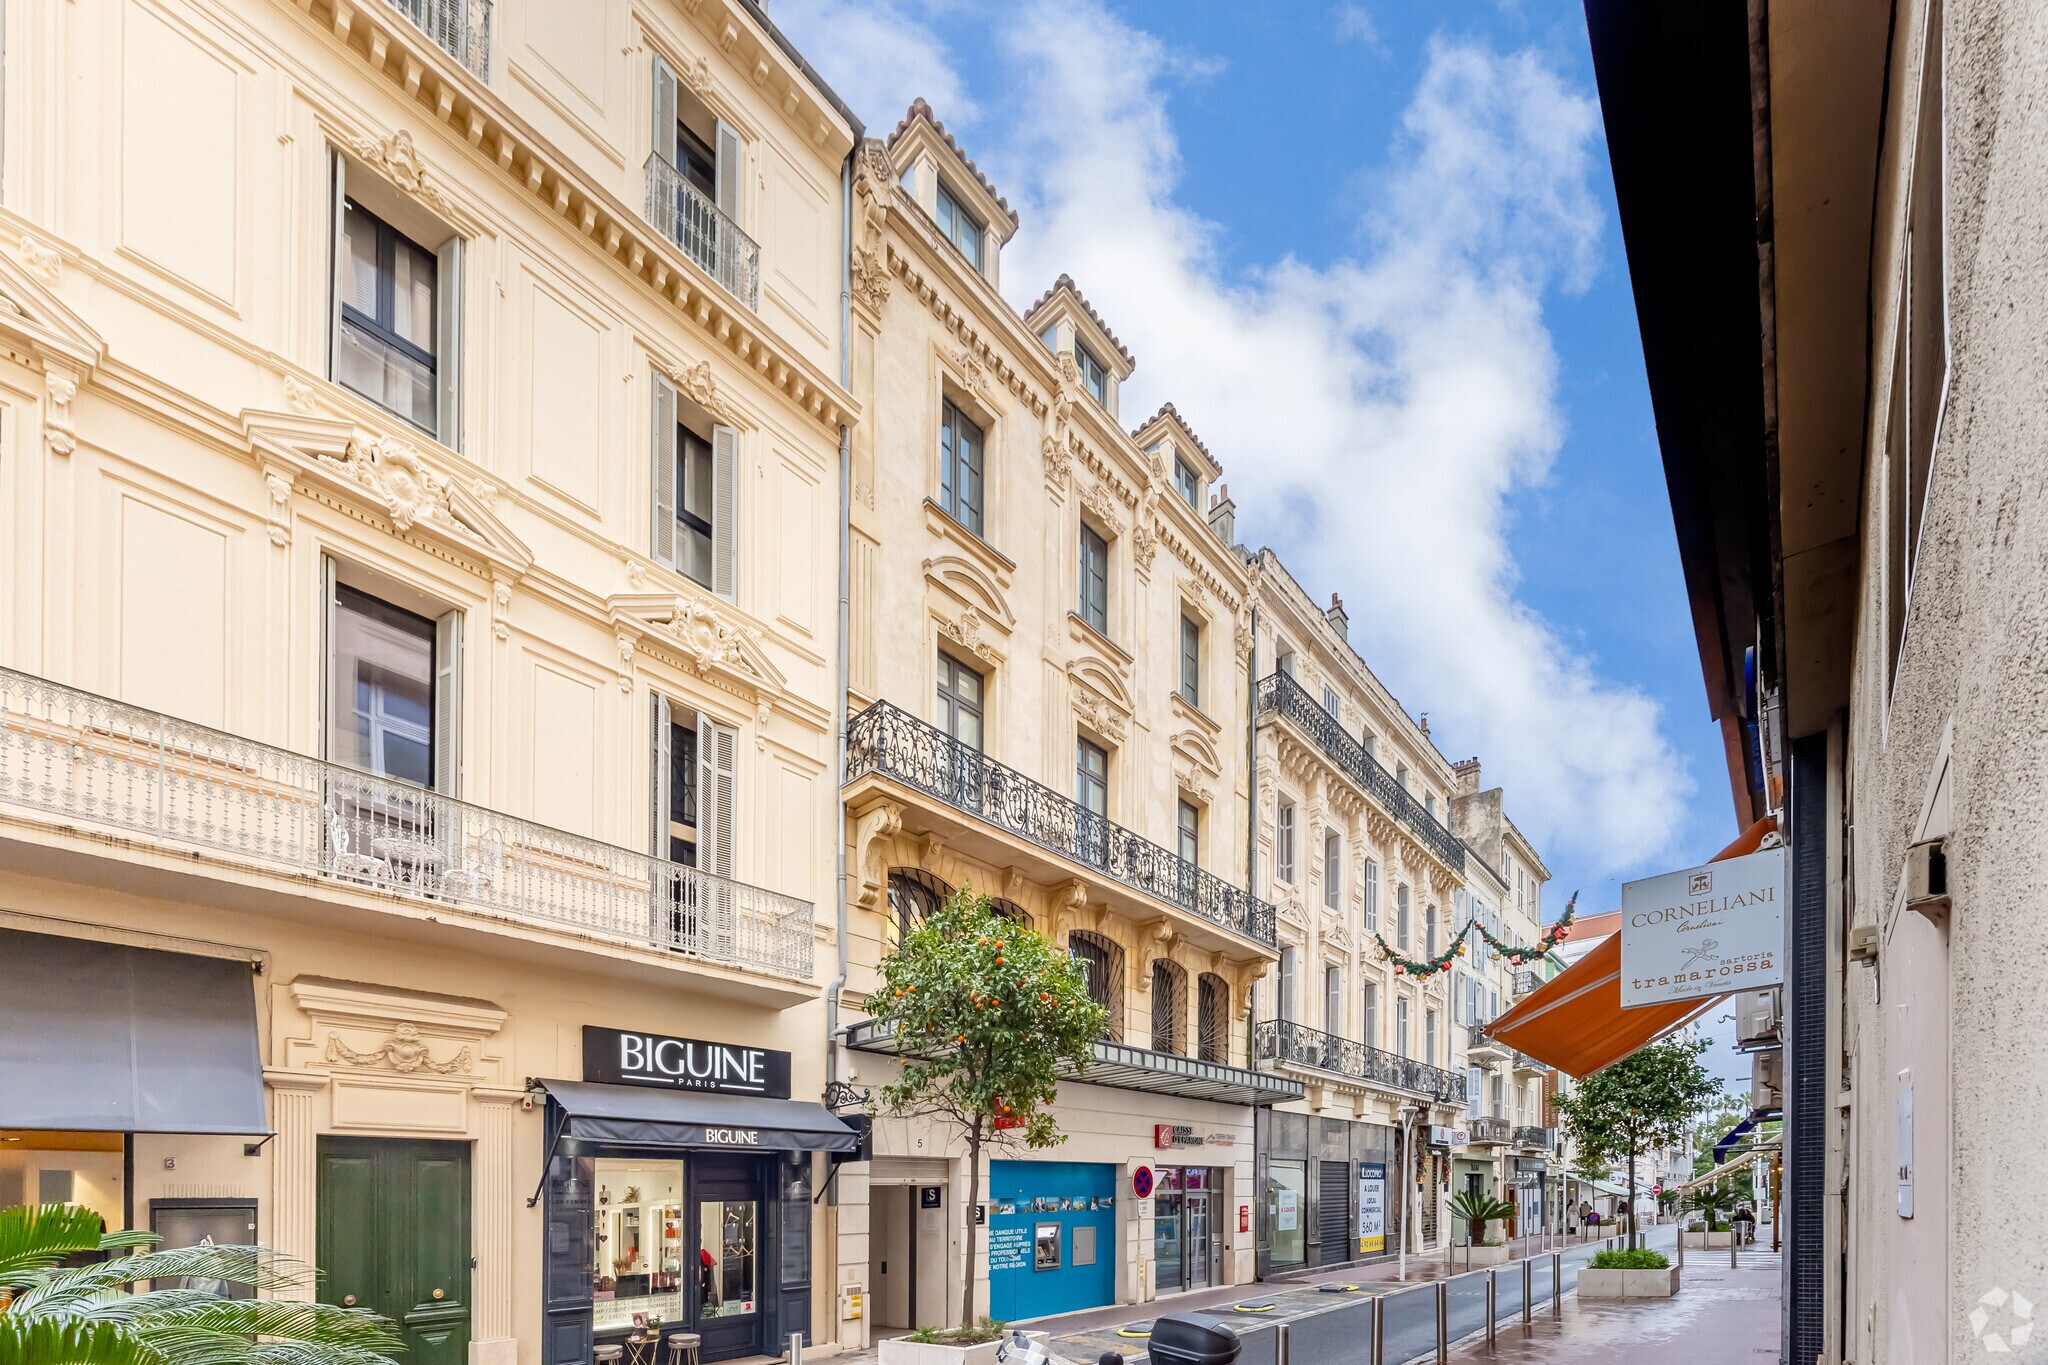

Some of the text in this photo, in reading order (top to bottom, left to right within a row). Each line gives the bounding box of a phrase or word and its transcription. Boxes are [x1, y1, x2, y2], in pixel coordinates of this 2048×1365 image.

[1632, 887, 1775, 928] CORNELIANI
[1720, 951, 1774, 966] sartoria
[1632, 959, 1774, 990] tramarossa
[620, 1033, 765, 1084] BIGUINE
[678, 1078, 716, 1089] PARIS
[705, 1128, 758, 1145] BIGUINE
[917, 1138, 923, 1149] 5
[166, 1158, 175, 1169] 3
[1363, 1184, 1380, 1193] A LOUER
[1362, 1221, 1373, 1234] 560
